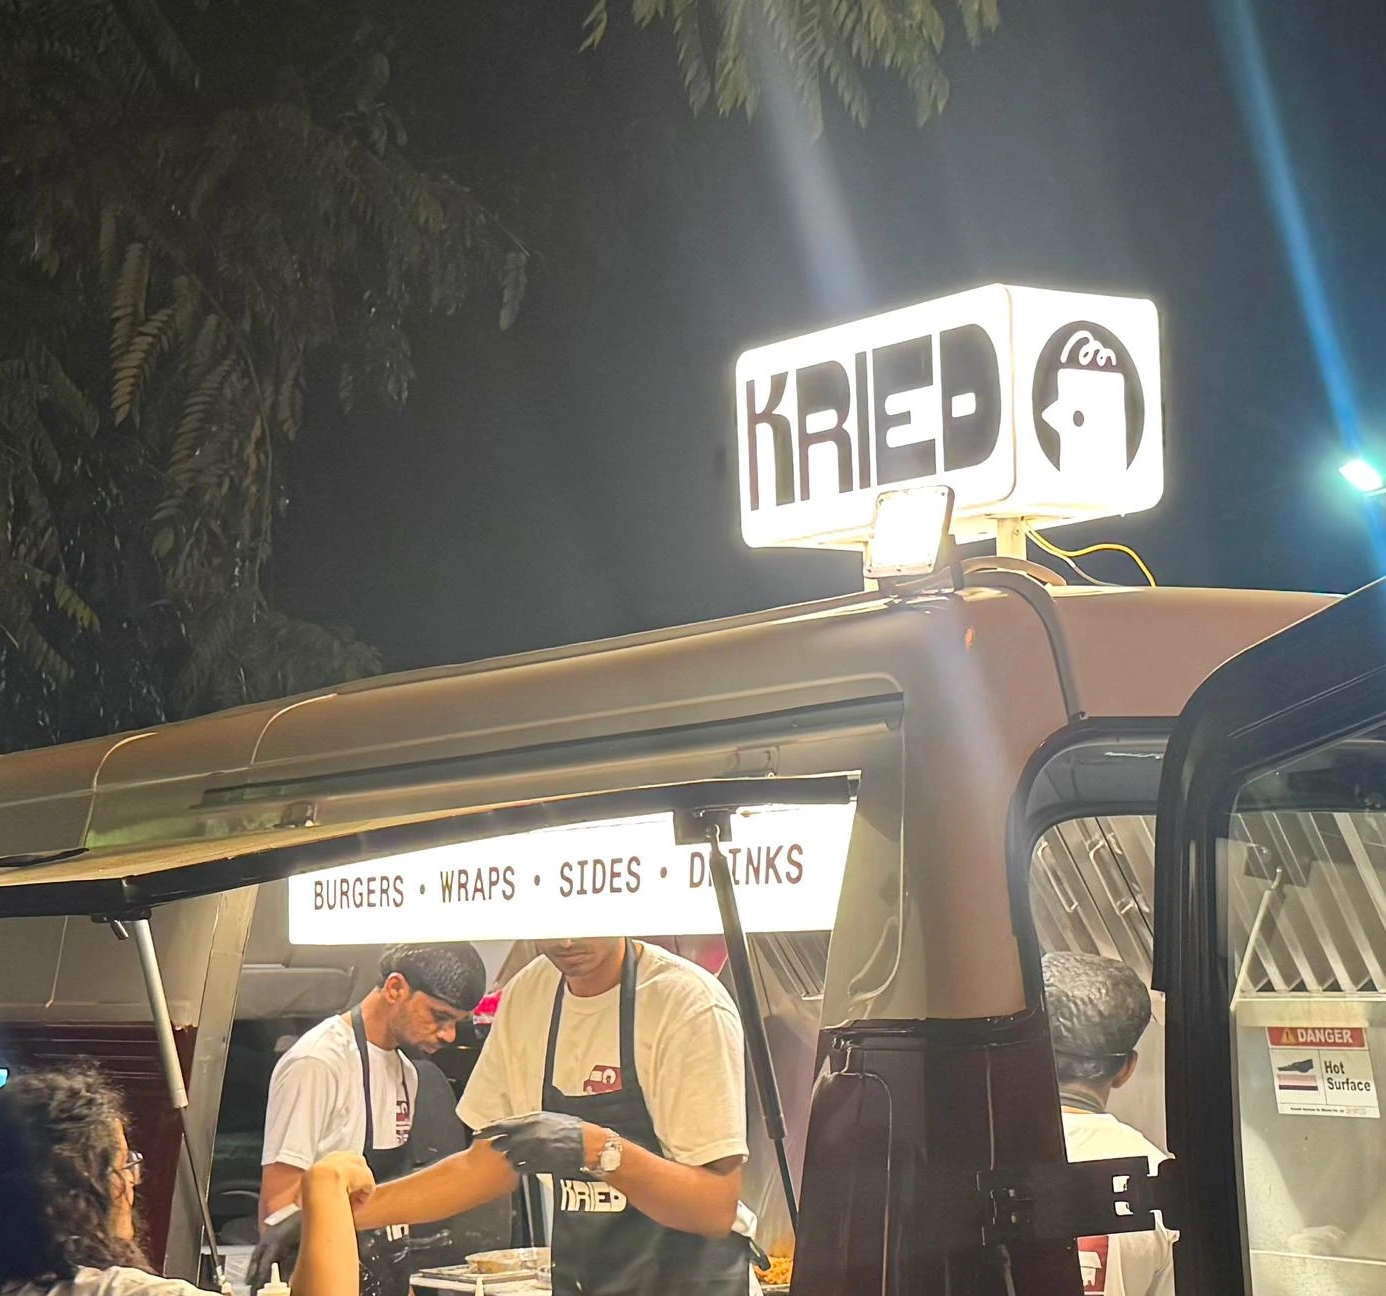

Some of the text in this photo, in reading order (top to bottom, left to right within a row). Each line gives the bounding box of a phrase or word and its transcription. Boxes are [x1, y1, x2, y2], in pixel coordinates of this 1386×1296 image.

[745, 322, 1002, 512] KRIED
[313, 843, 803, 911] BURGERS WRAPS SIDES DINKS
[1297, 1028, 1353, 1044] DANGER
[1324, 1060, 1345, 1075] Hot
[1326, 1077, 1371, 1093] Surface
[560, 1178, 627, 1212] KRIED
